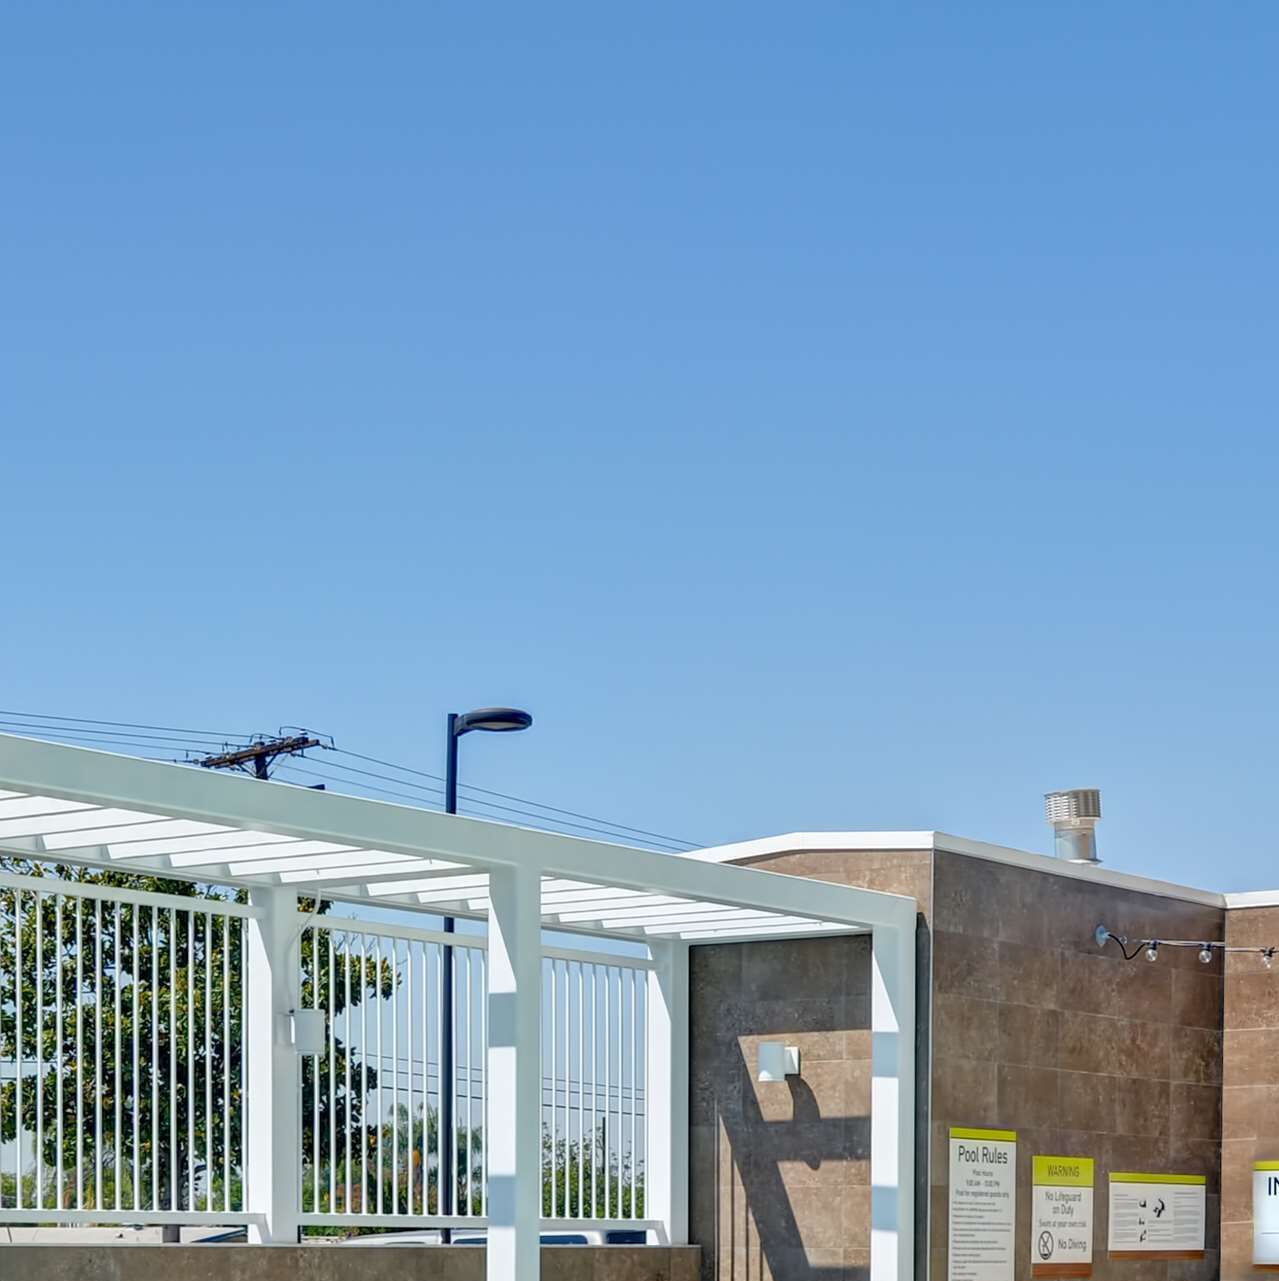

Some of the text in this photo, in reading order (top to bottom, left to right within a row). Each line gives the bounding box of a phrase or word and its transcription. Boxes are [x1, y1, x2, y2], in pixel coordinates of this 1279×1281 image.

[958, 1145, 1008, 1165] Pool Rules
[1047, 1164, 1080, 1177] WARNING
[1045, 1191, 1081, 1204] No Lifeguard
[1061, 1204, 1074, 1216] Duty
[1058, 1238, 1087, 1252] No Diving
